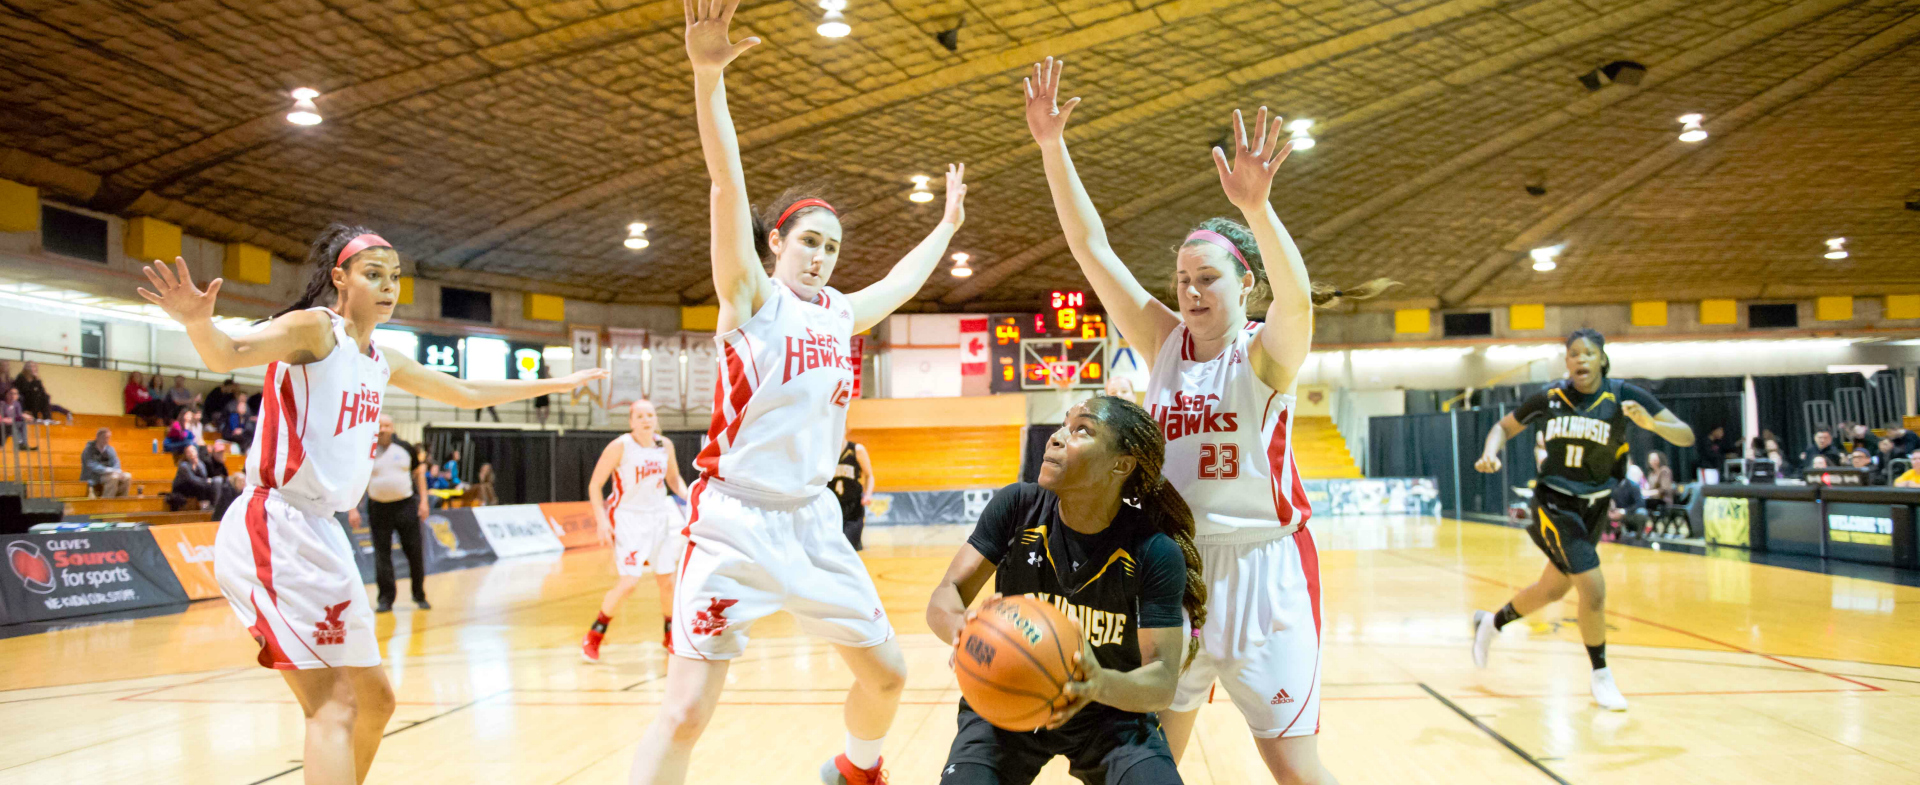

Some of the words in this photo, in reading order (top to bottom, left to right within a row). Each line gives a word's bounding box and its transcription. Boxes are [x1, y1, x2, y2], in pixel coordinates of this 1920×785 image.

[805, 327, 834, 349] Sea
[1170, 389, 1206, 412] Sea
[1545, 415, 1611, 446] DALHOUSIE
[1197, 442, 1240, 480] 23
[1564, 443, 1584, 468] 11
[46, 538, 91, 551] CLEVE'S
[53, 550, 130, 568] Source
[61, 568, 85, 588] for
[87, 566, 131, 589] sports
